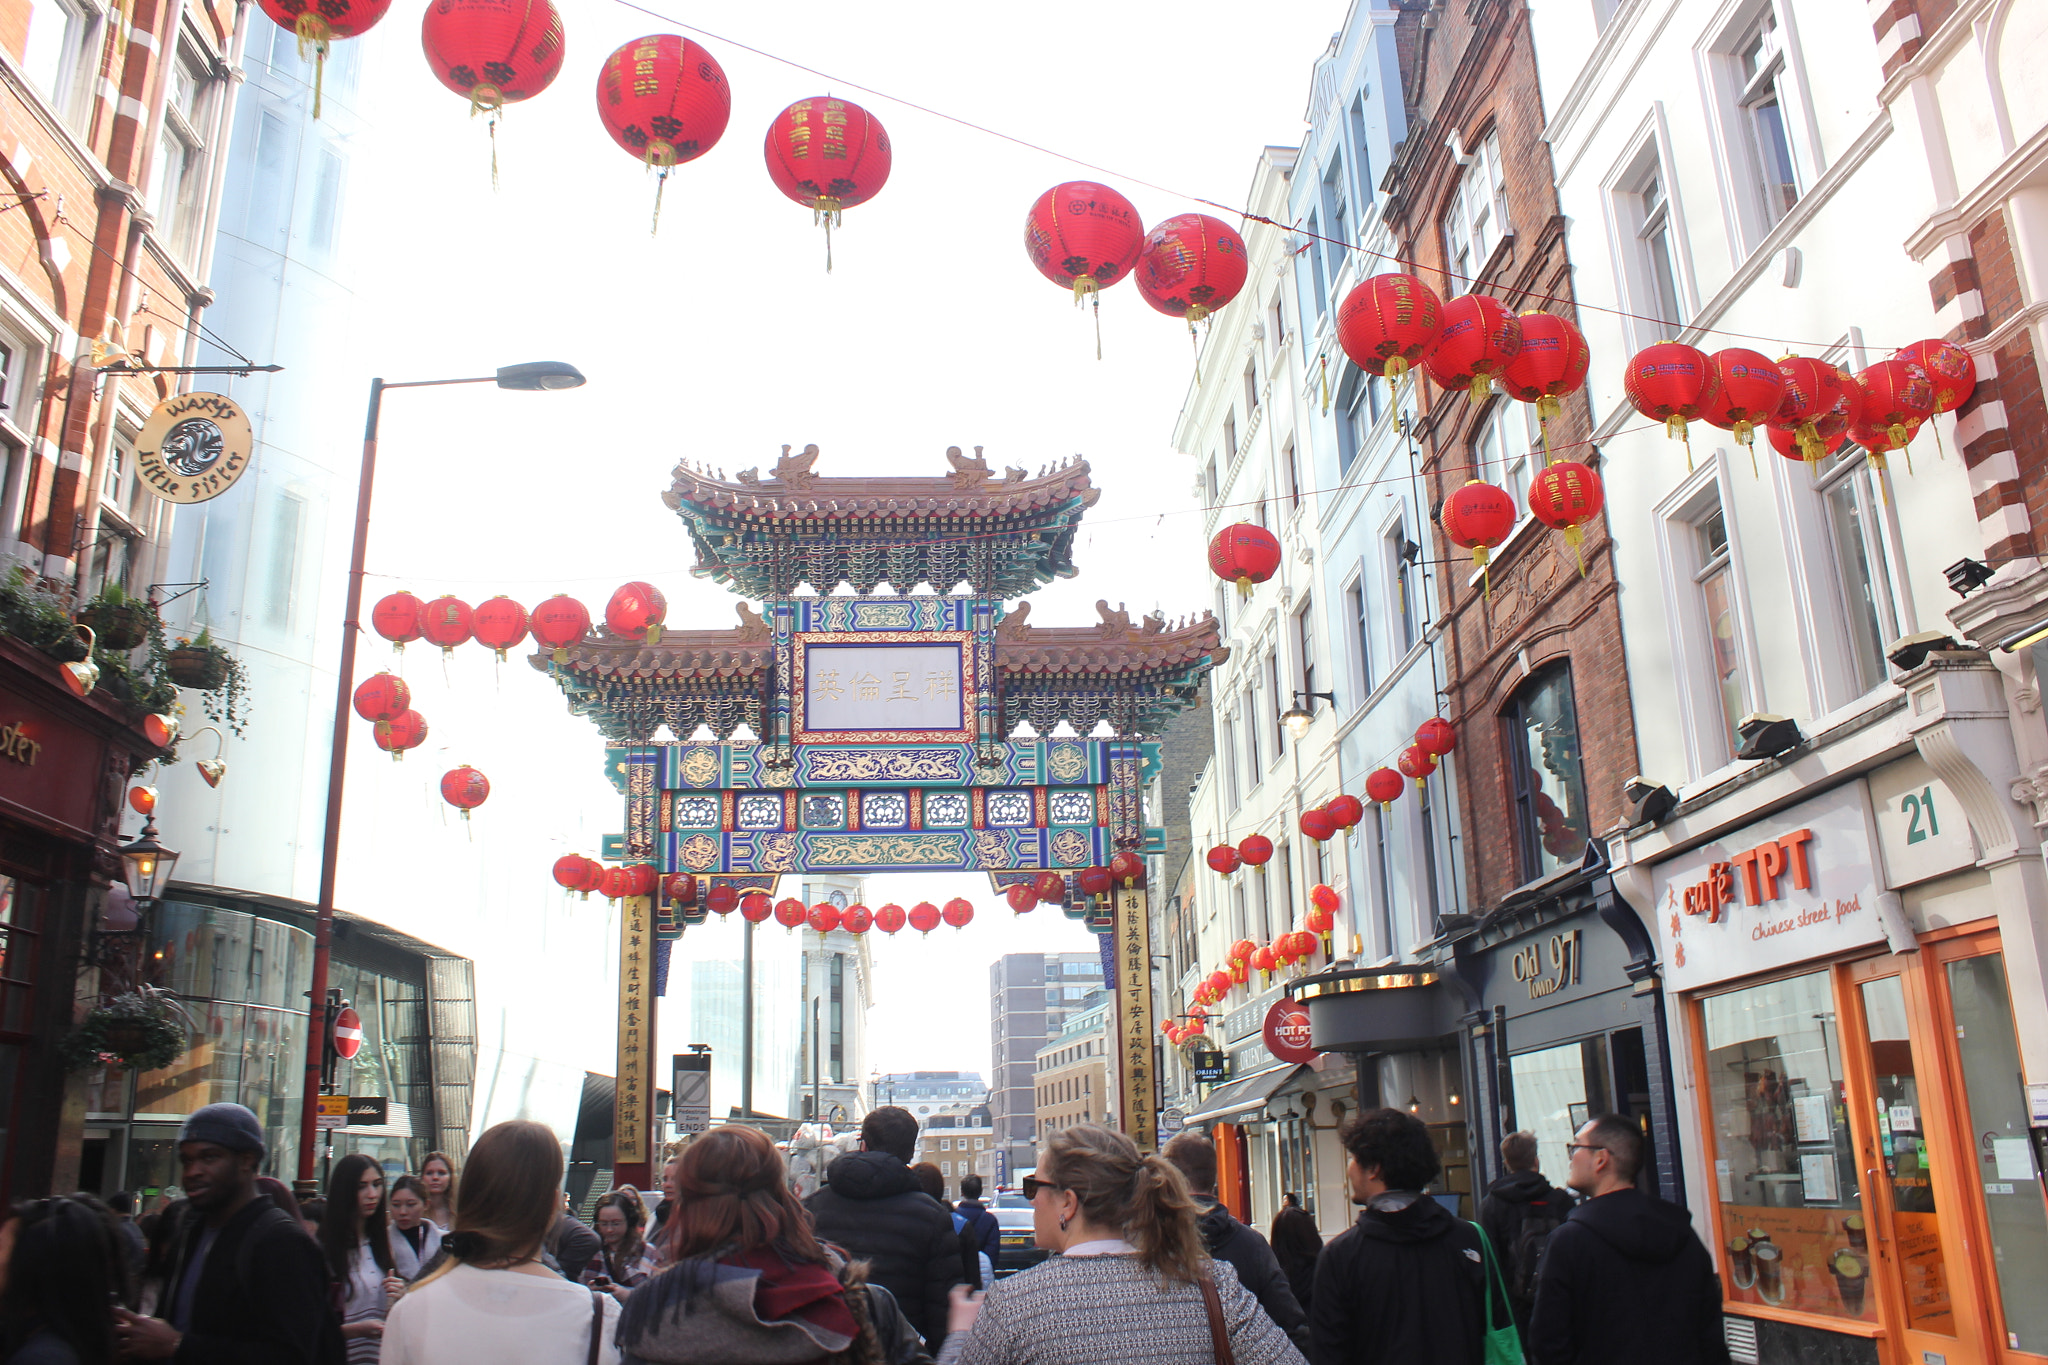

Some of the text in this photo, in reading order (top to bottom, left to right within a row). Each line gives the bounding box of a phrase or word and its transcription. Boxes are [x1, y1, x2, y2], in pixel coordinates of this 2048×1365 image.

[811, 669, 957, 702] 英倫呈祥
[0, 721, 41, 766] ster
[1901, 786, 1939, 846] 21
[1683, 828, 1813, 924] café TPT
[1752, 893, 1862, 942] Chinese street food
[1512, 943, 1541, 982] Old
[1549, 929, 1580, 994] 97
[1525, 977, 1556, 1000] Town
[1274, 1024, 1312, 1036] HOT PO
[1195, 1068, 1223, 1076] ORIENT
[680, 1123, 706, 1131] ENDS
